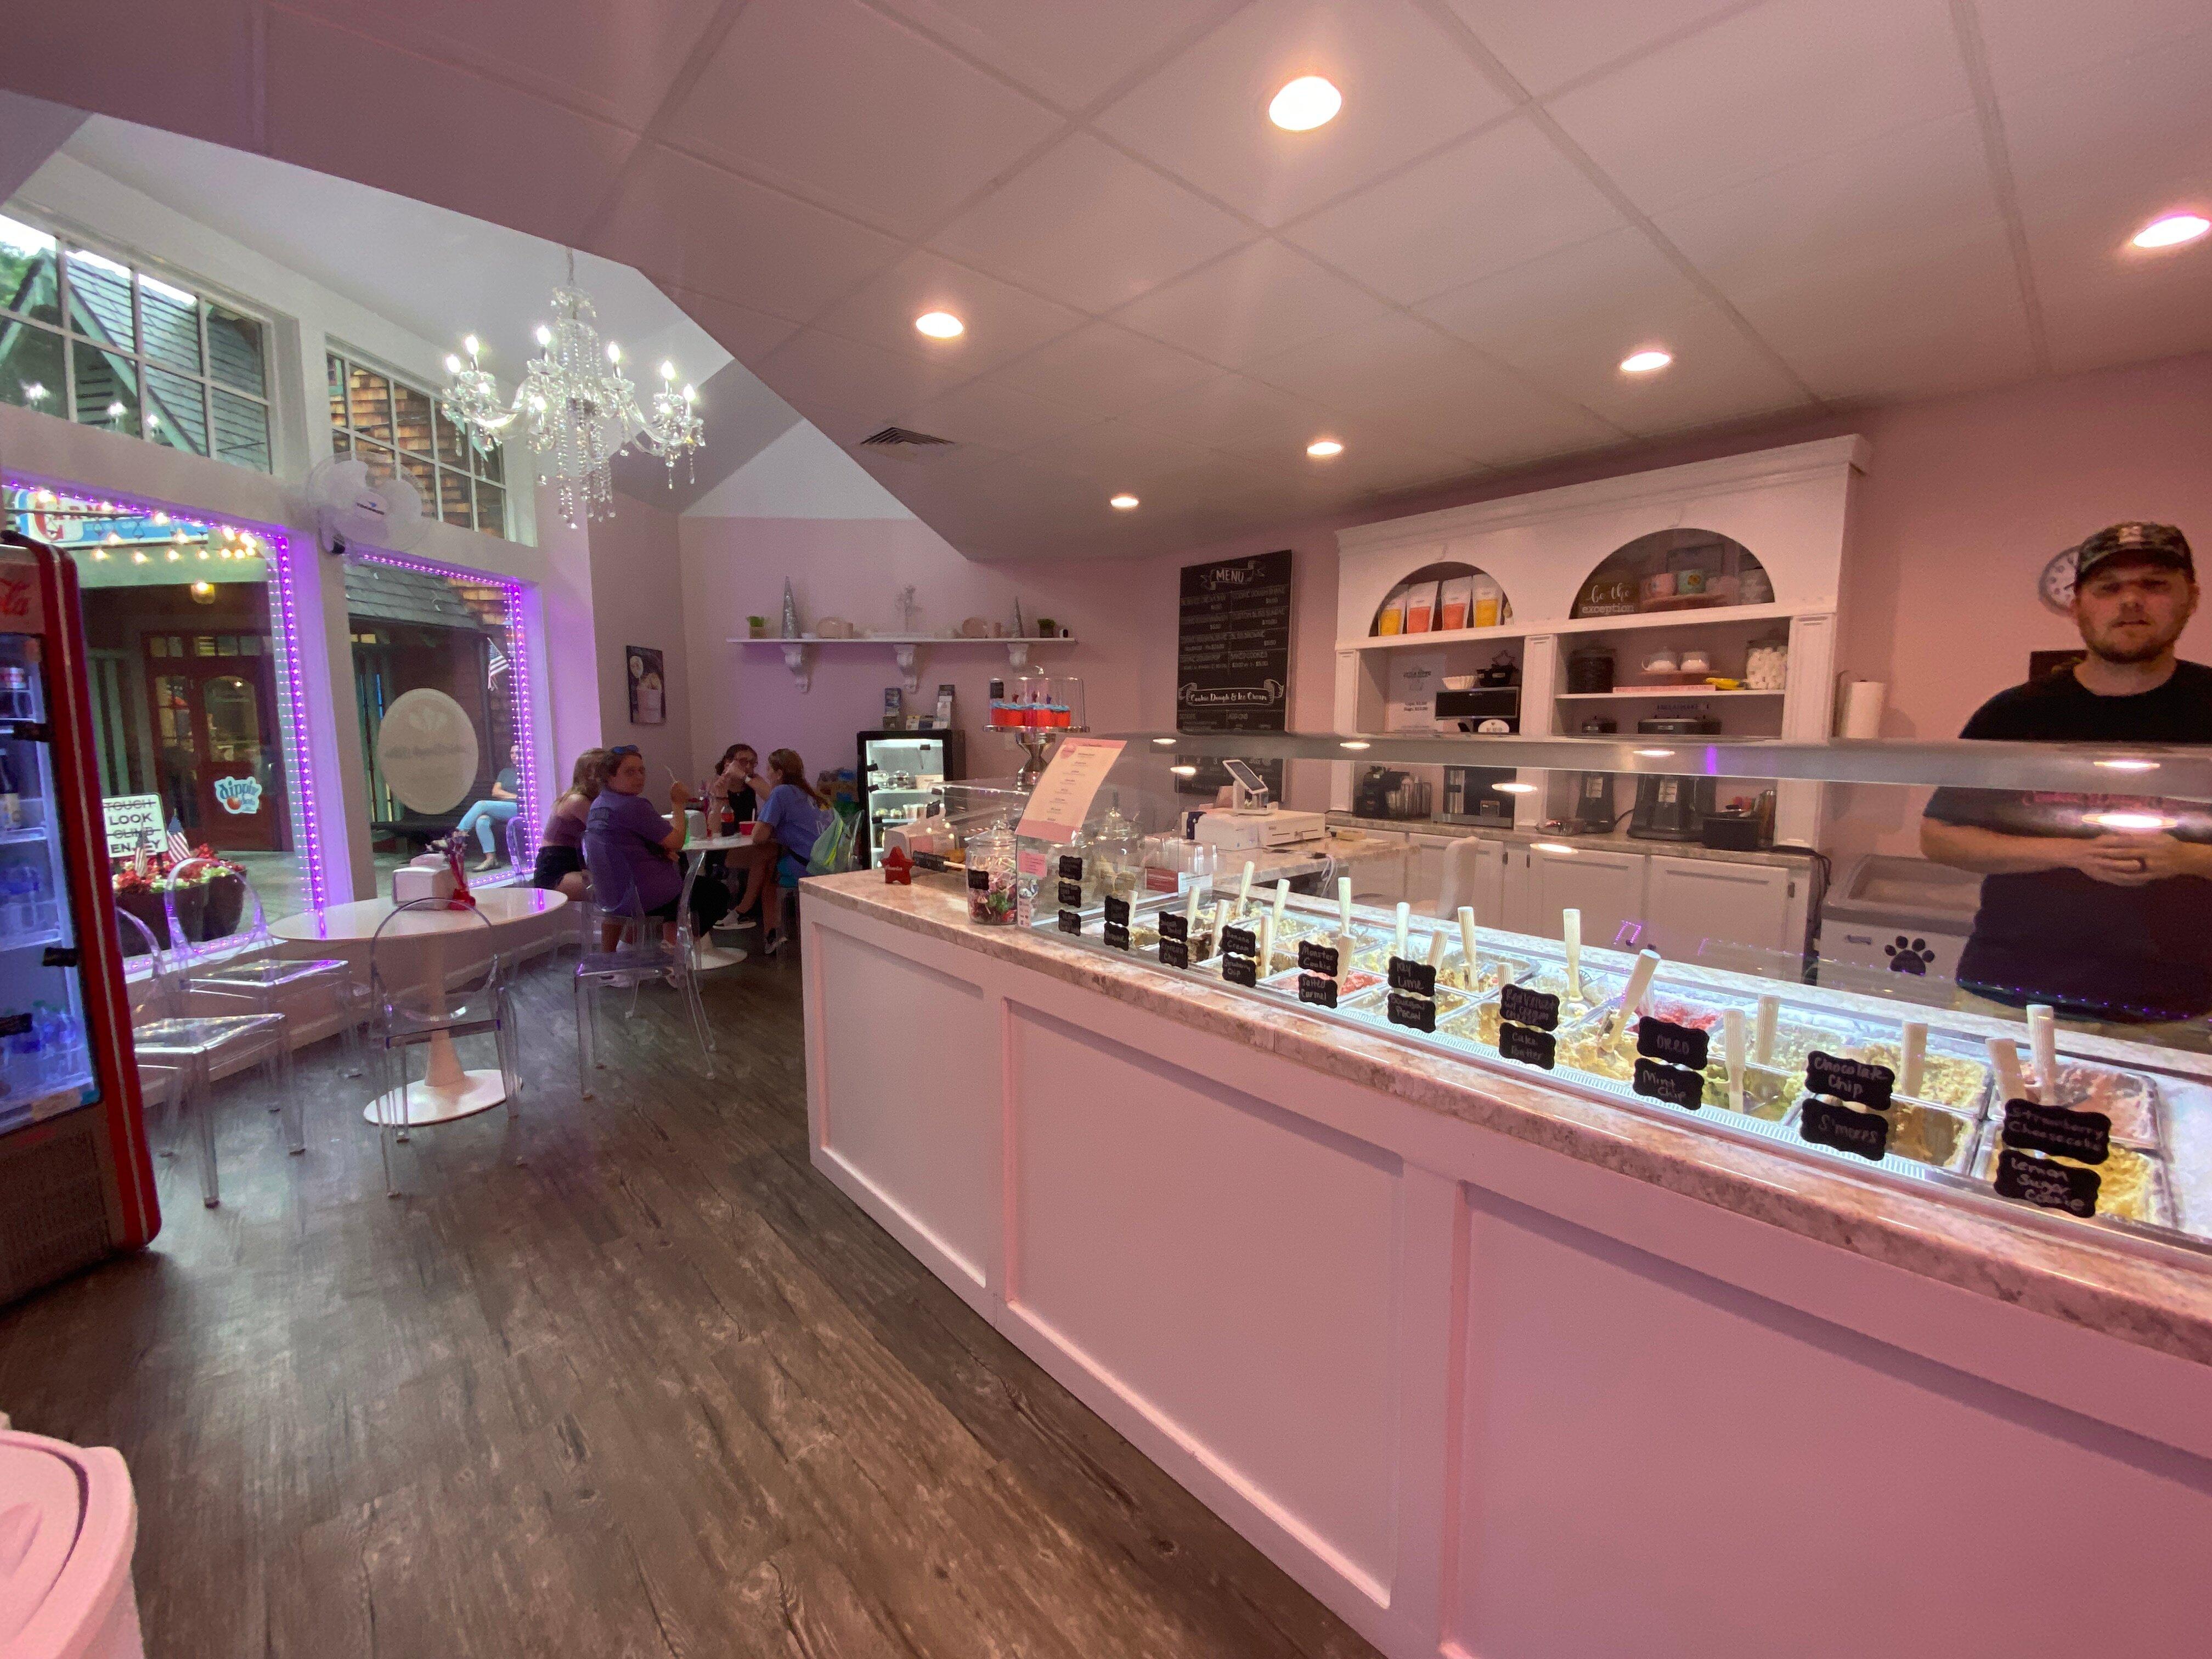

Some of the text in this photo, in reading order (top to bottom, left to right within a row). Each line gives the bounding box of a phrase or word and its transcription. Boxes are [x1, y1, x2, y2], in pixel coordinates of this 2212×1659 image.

[1216, 569, 1244, 583] MENU
[1585, 583, 1629, 602] be the
[1582, 603, 1635, 615] exception
[1210, 693, 1229, 702] Dough
[1247, 692, 1267, 701] Cream
[109, 812, 154, 825] LOOK
[110, 839, 160, 854] ENY
[1226, 930, 1250, 944] Banana
[1227, 939, 1249, 951] Cream
[1301, 945, 1333, 961] Monster
[1303, 957, 1333, 971] Cookie
[1302, 977, 1326, 989] Salted
[1398, 976, 1425, 990] Lime
[1511, 1032, 1538, 1046] Cake
[1657, 1034, 1690, 1055] OREO
[1814, 1057, 1889, 1081] Chocolate
[1643, 1070, 1675, 1088] Mint
[1829, 1074, 1863, 1098] Chip
[1658, 1086, 1686, 1103] Chip
[2008, 1107, 2103, 1140] Strawberry
[2008, 1120, 2102, 1152] Cheesecake
[2011, 1157, 2069, 1181] Lemon
